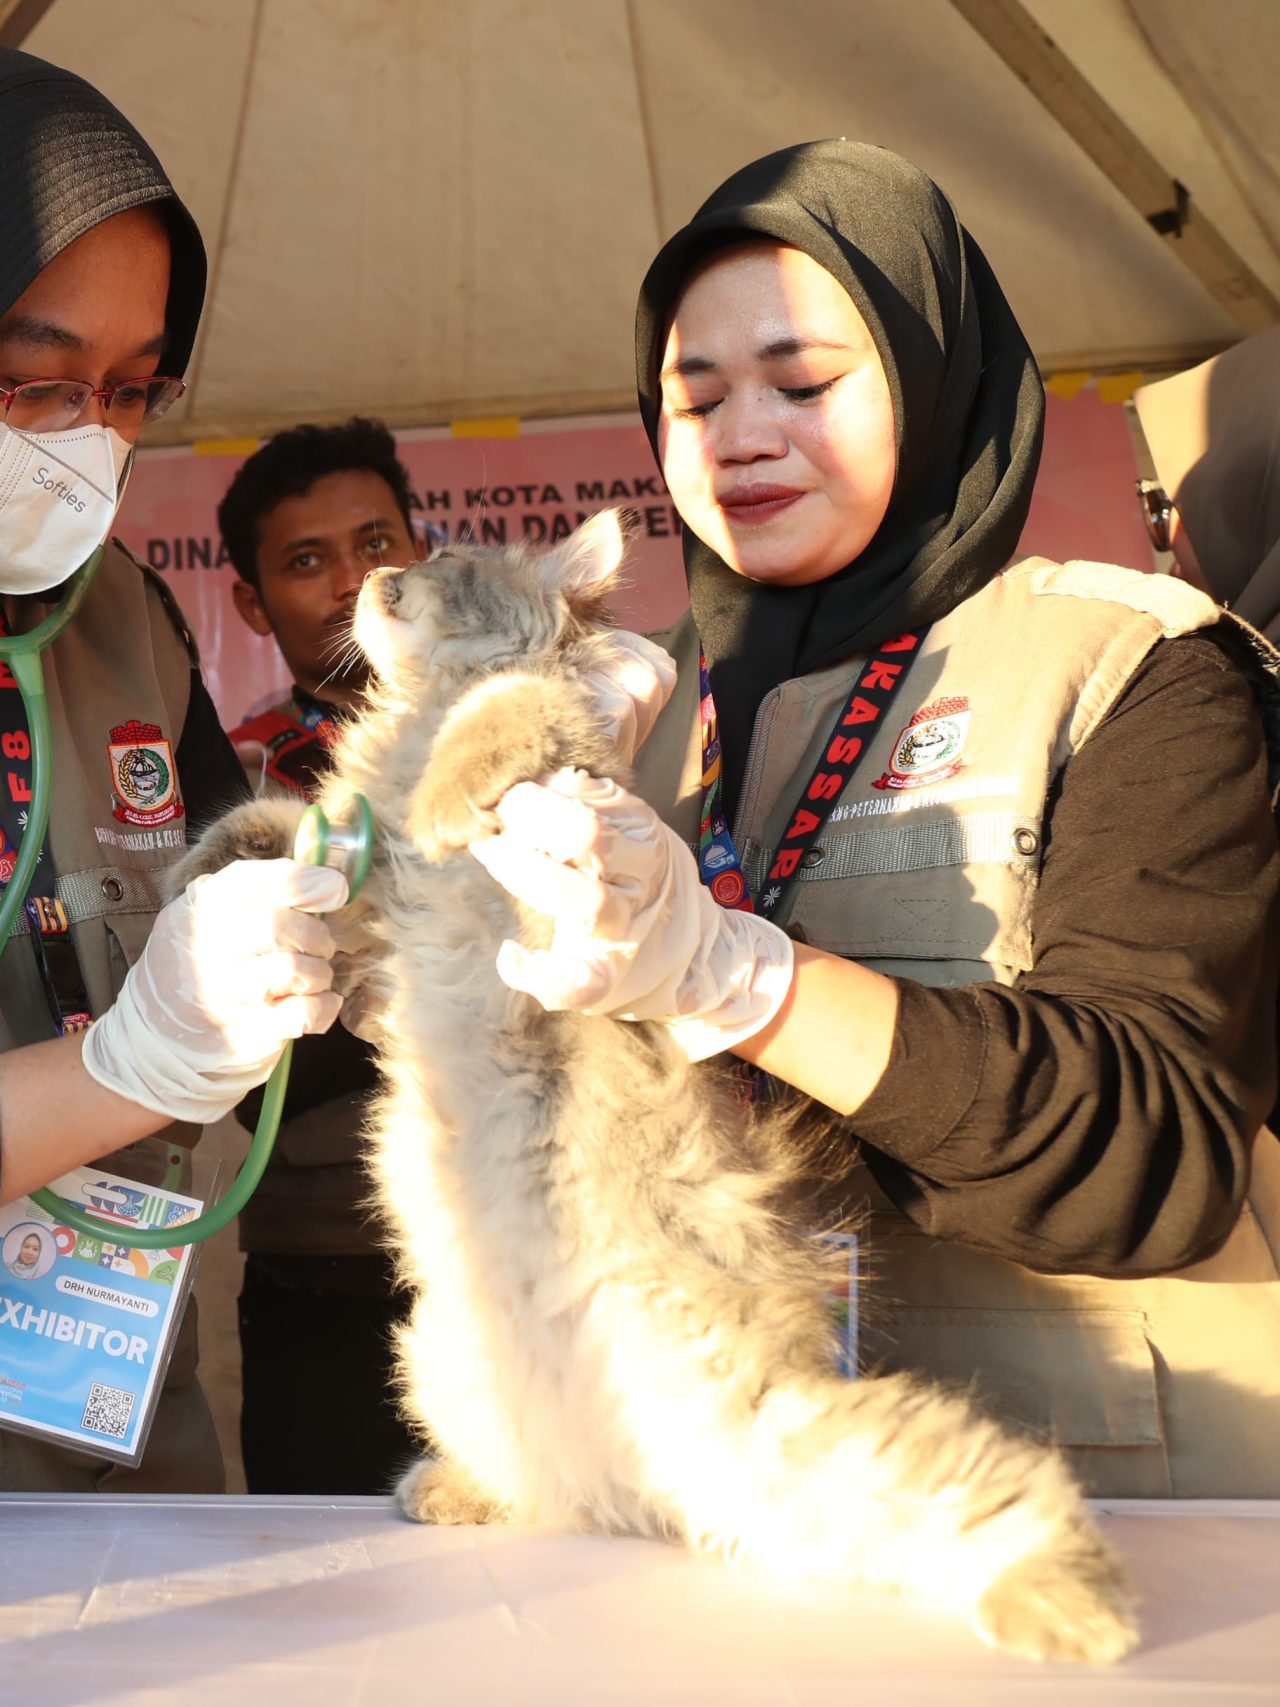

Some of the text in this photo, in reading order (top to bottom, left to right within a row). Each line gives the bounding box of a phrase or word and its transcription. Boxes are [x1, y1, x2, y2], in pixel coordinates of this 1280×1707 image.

[32, 467, 86, 513] Softies
[408, 477, 670, 511] AH KOTA MAK
[147, 536, 232, 571] DINA
[770, 633, 918, 880] AKASSAR
[63, 1280, 149, 1312] DRH NURMAYANTI
